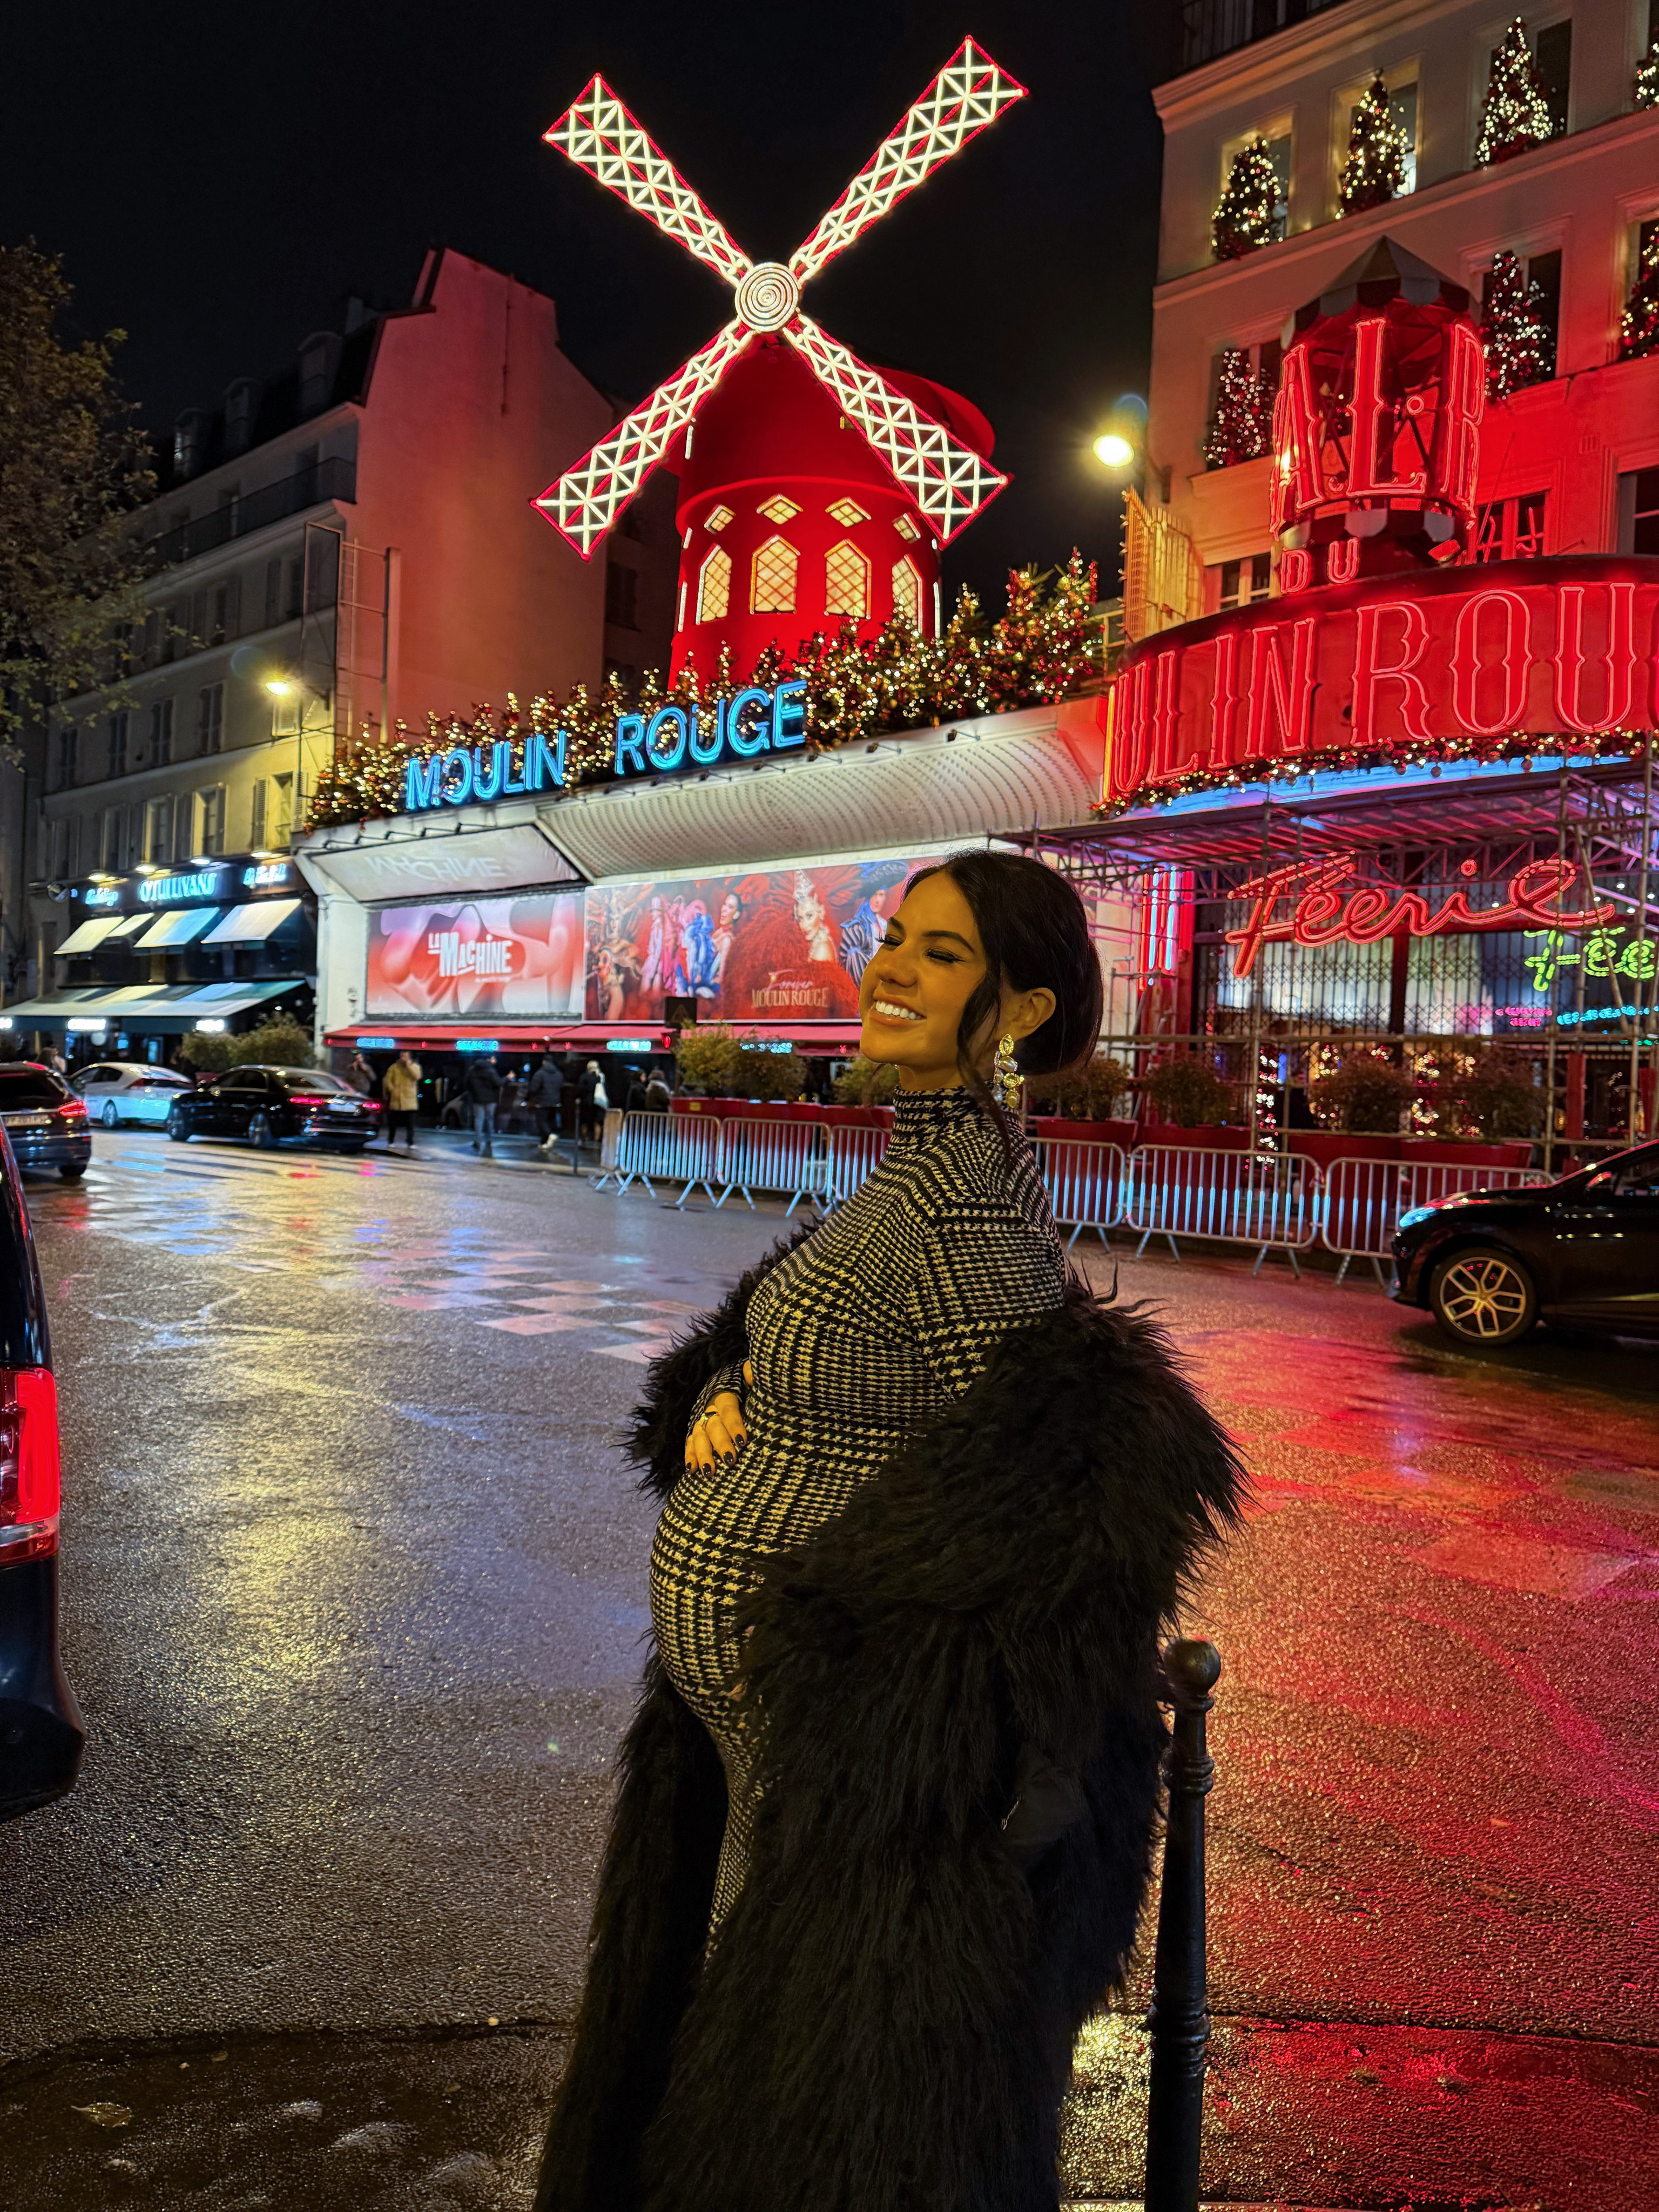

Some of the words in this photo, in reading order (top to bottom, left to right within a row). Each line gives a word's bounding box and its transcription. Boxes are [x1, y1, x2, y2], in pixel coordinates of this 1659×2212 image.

[1279, 536, 1361, 595] DU
[1350, 582, 1659, 747] ROU
[405, 729, 565, 810] MOULIN
[614, 679, 807, 775] ROUGE
[439, 931, 513, 977] MACHINE
[751, 989, 790, 1008] MOULIN
[791, 987, 829, 1008] ROUGE
